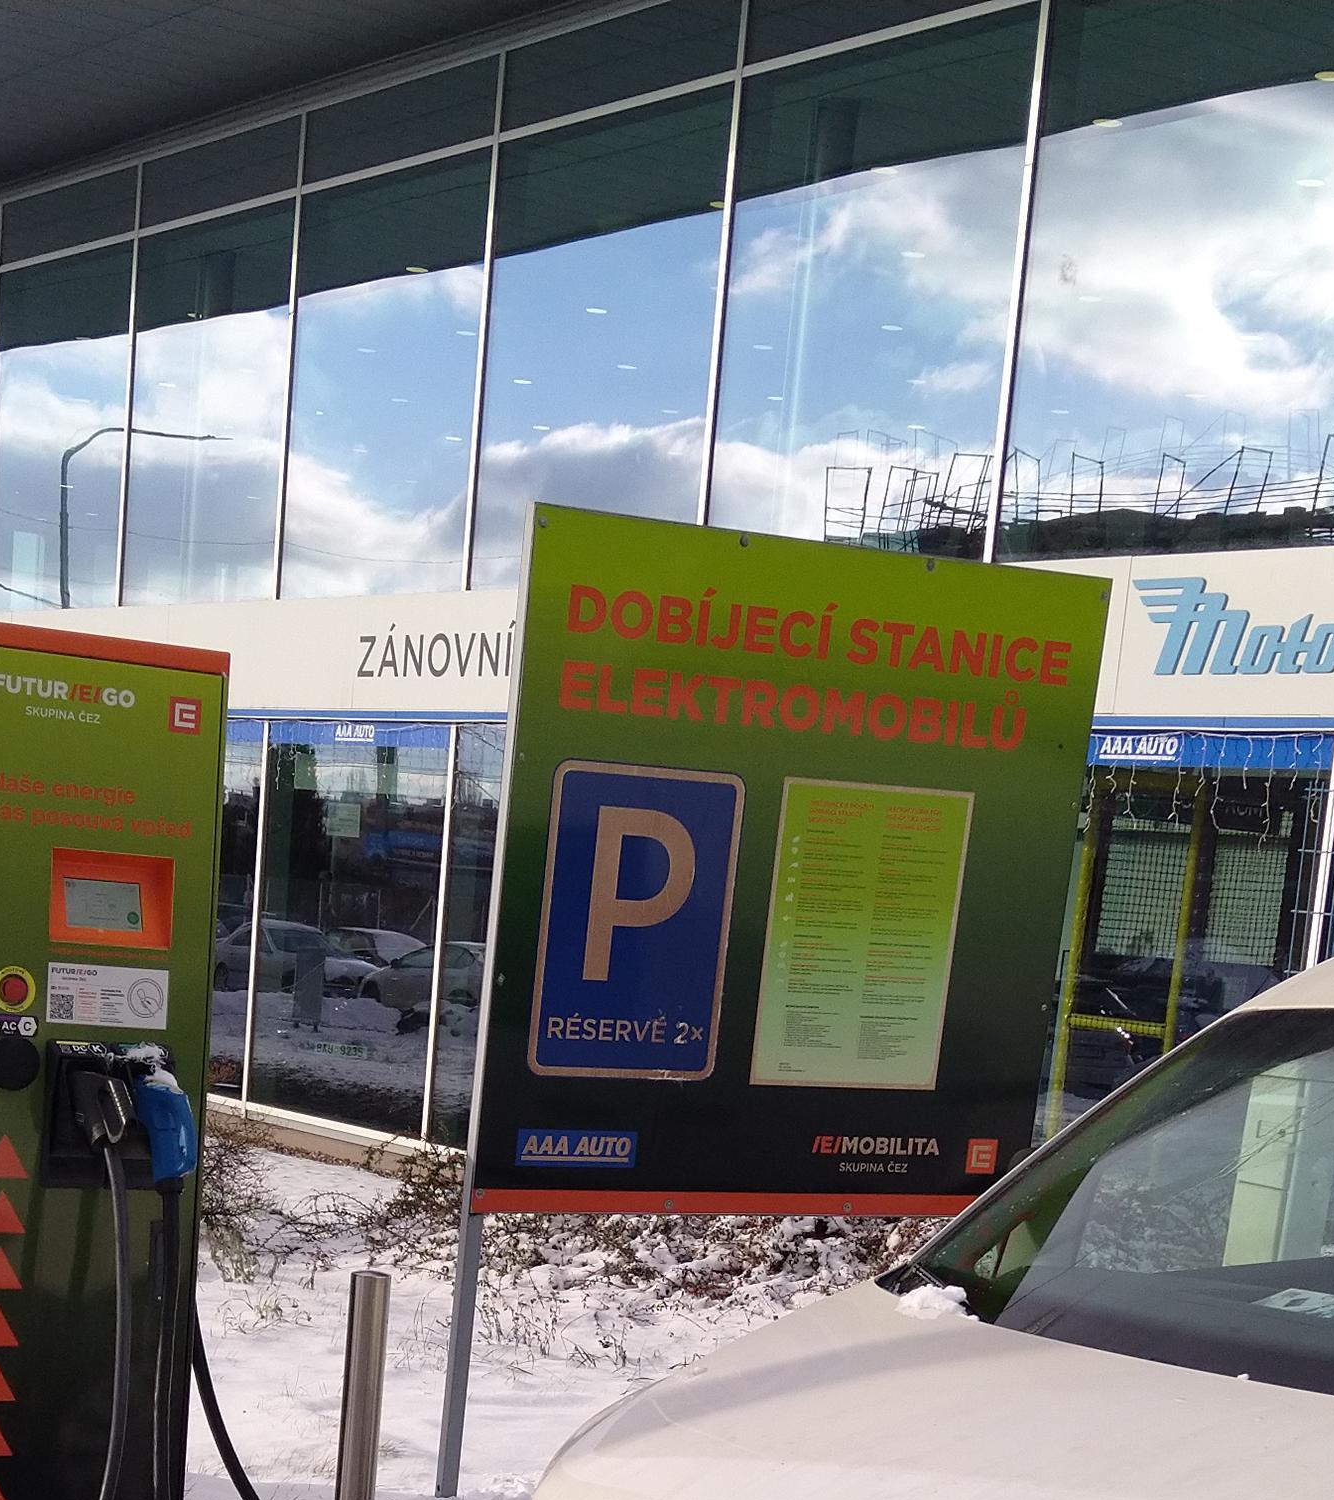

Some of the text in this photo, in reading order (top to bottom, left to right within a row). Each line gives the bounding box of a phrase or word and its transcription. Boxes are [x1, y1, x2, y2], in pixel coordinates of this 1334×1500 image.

[567, 584, 1072, 686] DOBÍJECÍ STANICE
[357, 620, 516, 677] ZÁNOVNÍ
[25, 706, 101, 724] SKUPINA ČEZ
[559, 660, 1027, 752] ELEKTROMOBILŮ
[335, 725, 375, 738] AAA AUTO
[1099, 736, 1179, 756] AAA AUTO
[51, 783, 137, 807] energie
[581, 805, 697, 981] P
[2, 1021, 17, 1031] AC
[547, 1013, 668, 1043] RÉSERVÉ
[522, 1135, 632, 1157] AAA AUTO
[838, 1160, 908, 1173] SKUPINA ČEZ
